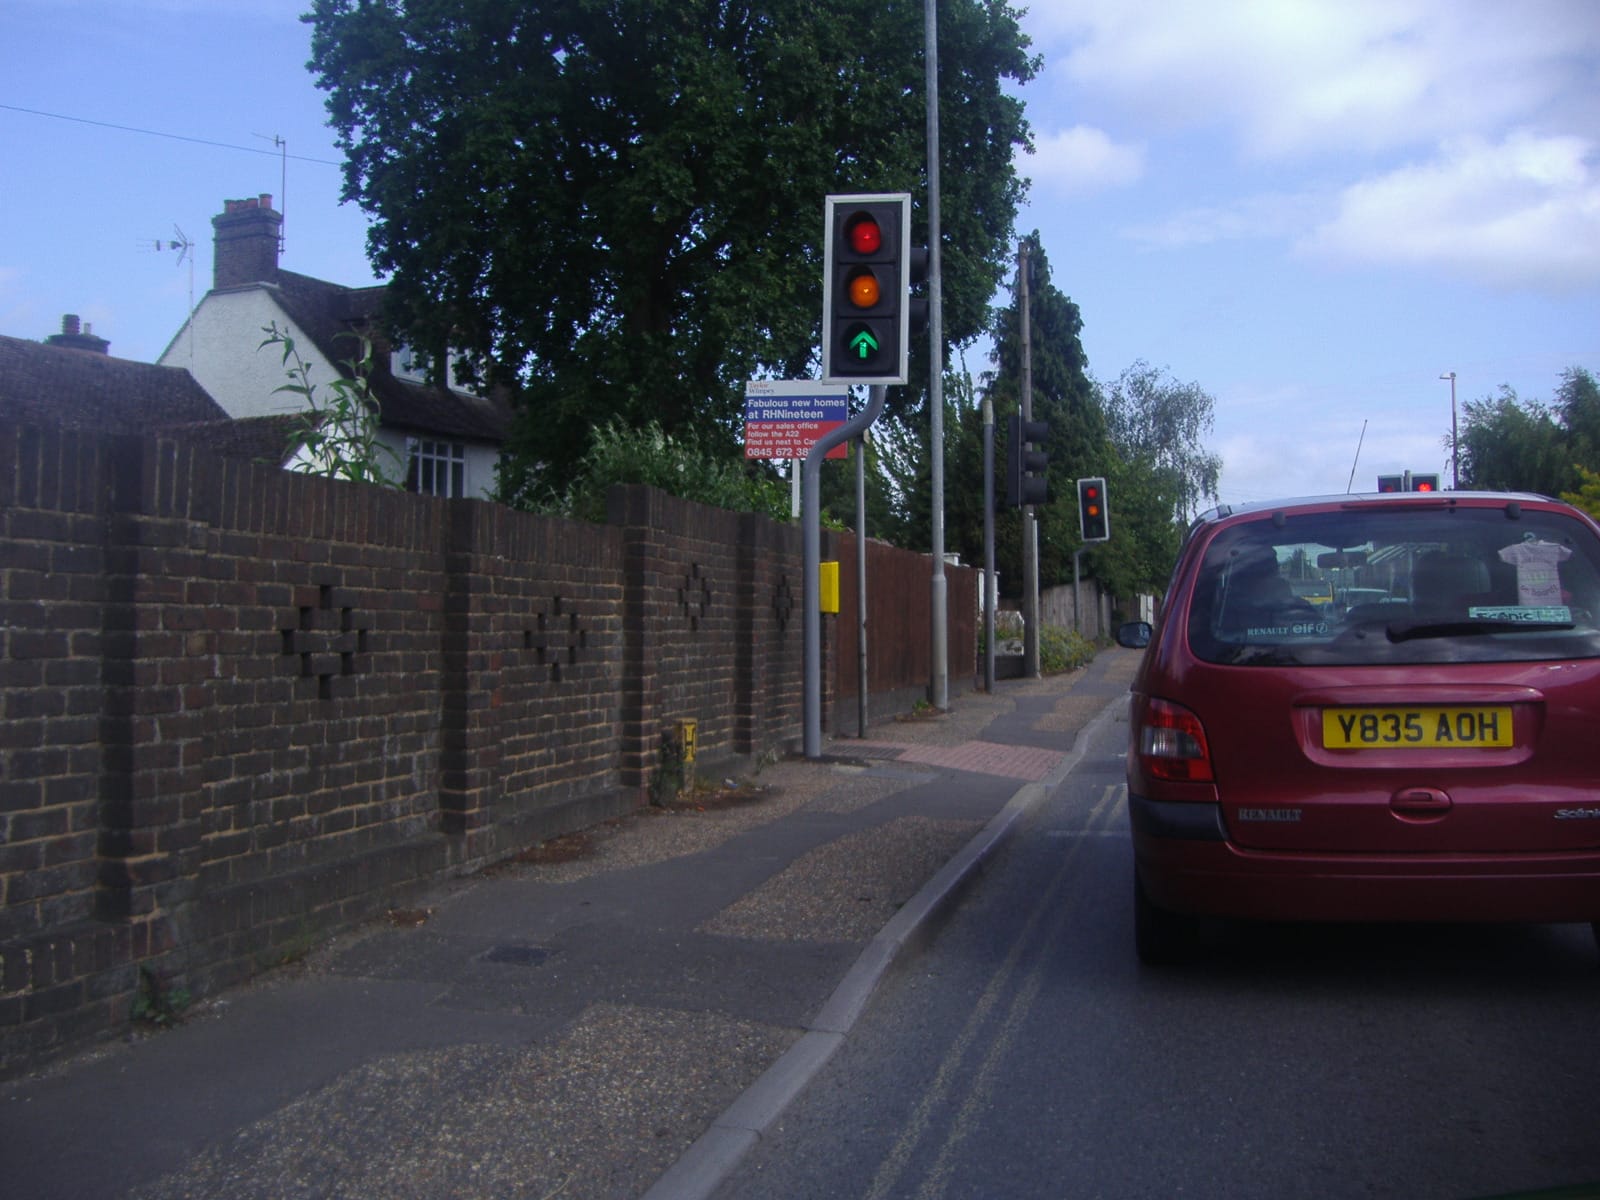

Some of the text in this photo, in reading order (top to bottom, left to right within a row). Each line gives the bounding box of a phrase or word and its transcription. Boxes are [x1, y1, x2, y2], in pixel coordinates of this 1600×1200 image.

[748, 398, 845, 408] Fabulous new homes
[747, 409, 824, 419] at RHNineteen
[775, 422, 795, 430] sales
[797, 422, 819, 430] office
[785, 430, 800, 438] A22
[747, 438, 762, 446] Find
[747, 447, 811, 457] 0845 672 38
[1247, 627, 1288, 636] RENAULT
[1337, 712, 1498, 743] Y835 AOH
[1238, 808, 1302, 822] RENAULT
